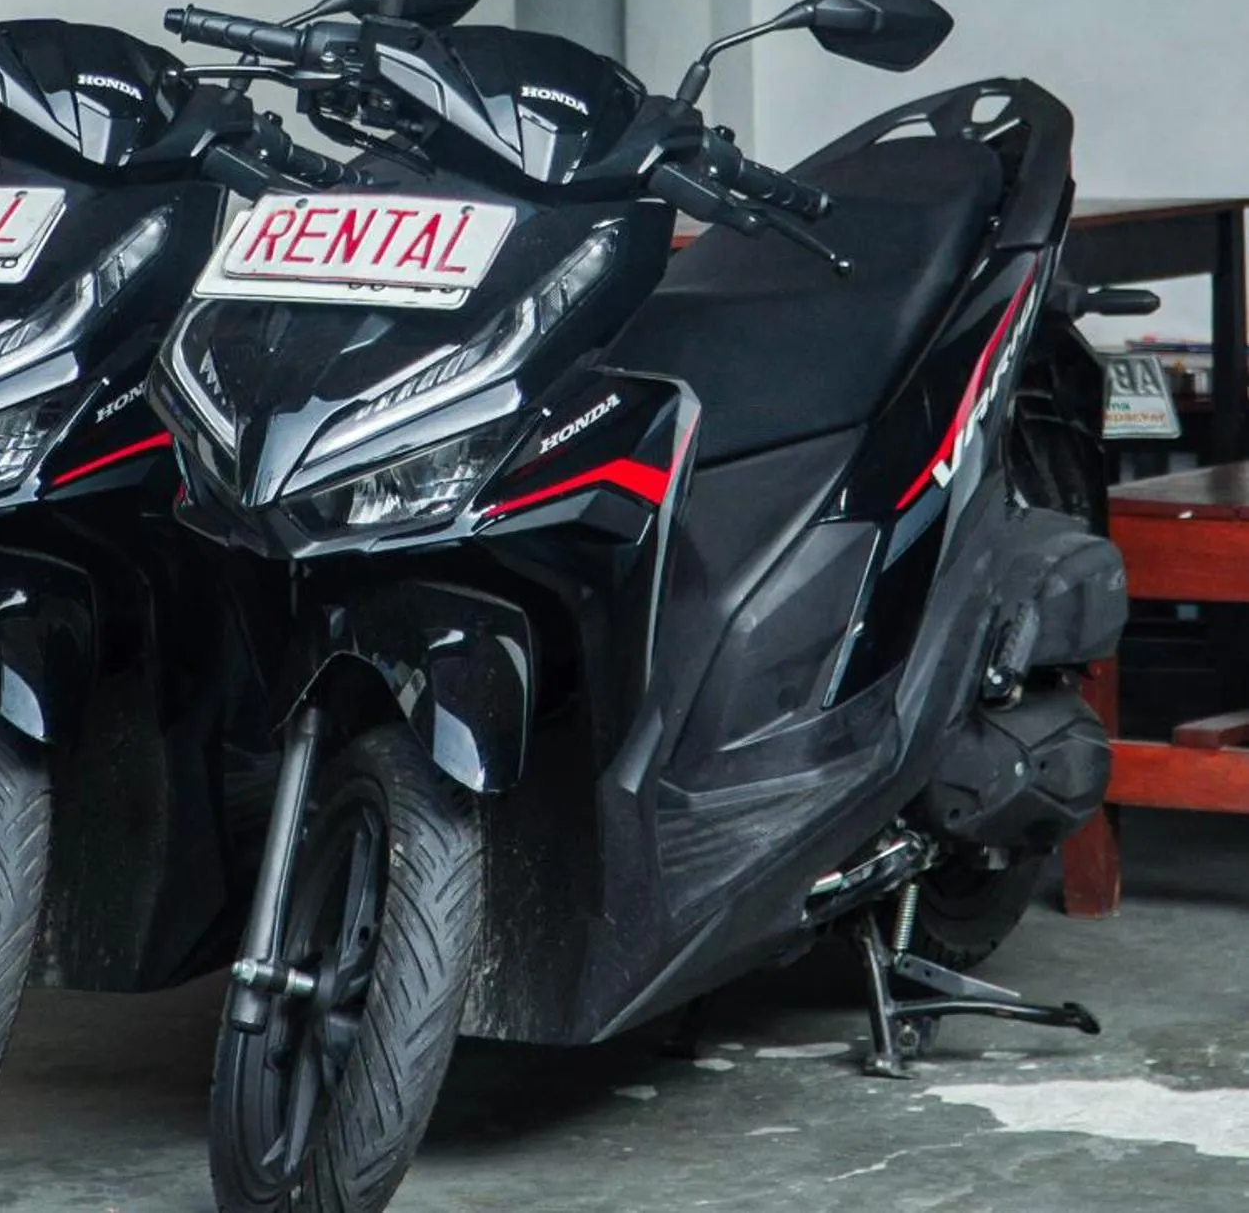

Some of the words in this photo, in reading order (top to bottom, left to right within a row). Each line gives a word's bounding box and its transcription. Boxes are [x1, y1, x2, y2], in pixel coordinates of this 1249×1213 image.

[78, 74, 142, 100] HONDA
[521, 86, 589, 115] HONDA
[243, 208, 471, 273] RENTAL
[95, 381, 146, 424] HON
[539, 393, 621, 455] HONDA
